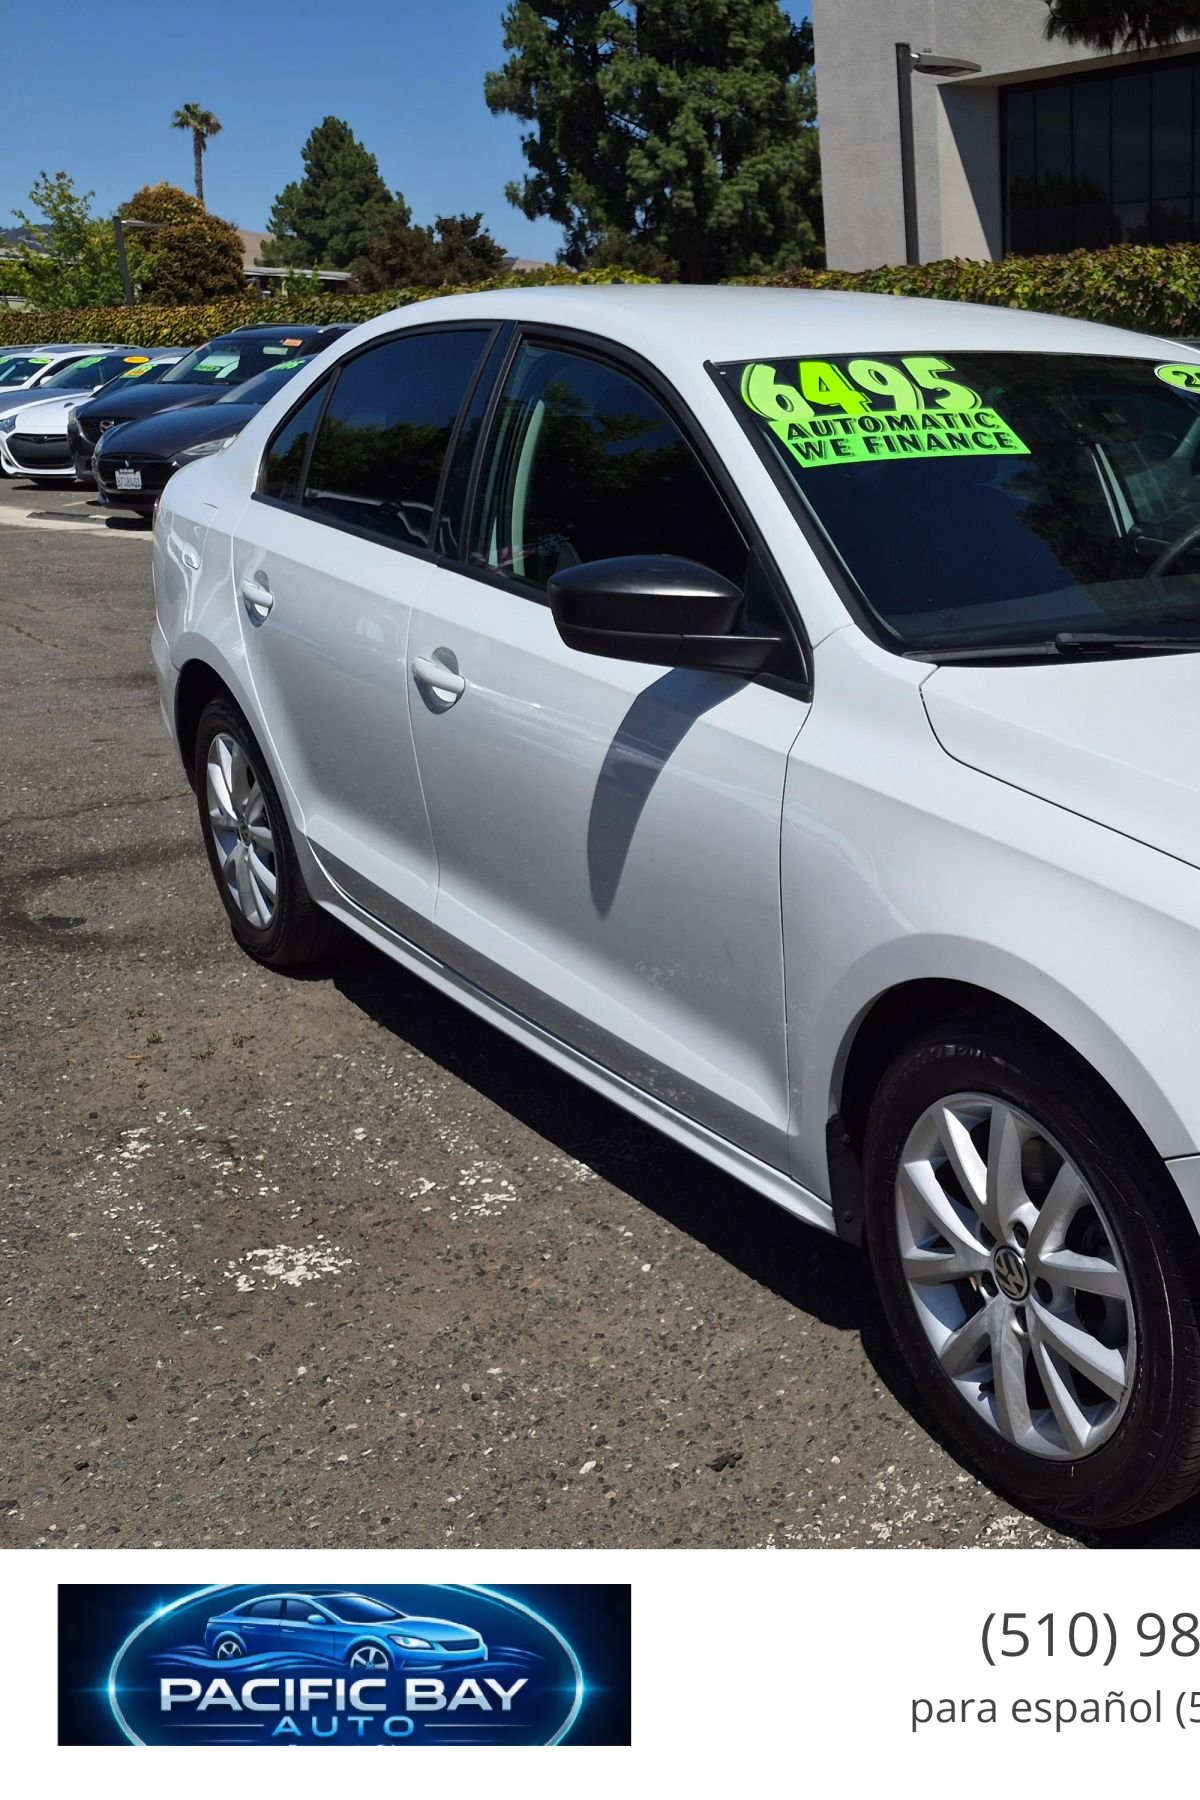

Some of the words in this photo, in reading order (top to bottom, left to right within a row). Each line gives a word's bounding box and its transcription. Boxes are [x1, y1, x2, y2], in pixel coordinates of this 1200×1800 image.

[741, 357, 982, 422] 6495
[787, 411, 1001, 441] AUTOMATIC
[792, 437, 854, 461] WE
[863, 431, 1022, 455] FINANCE
